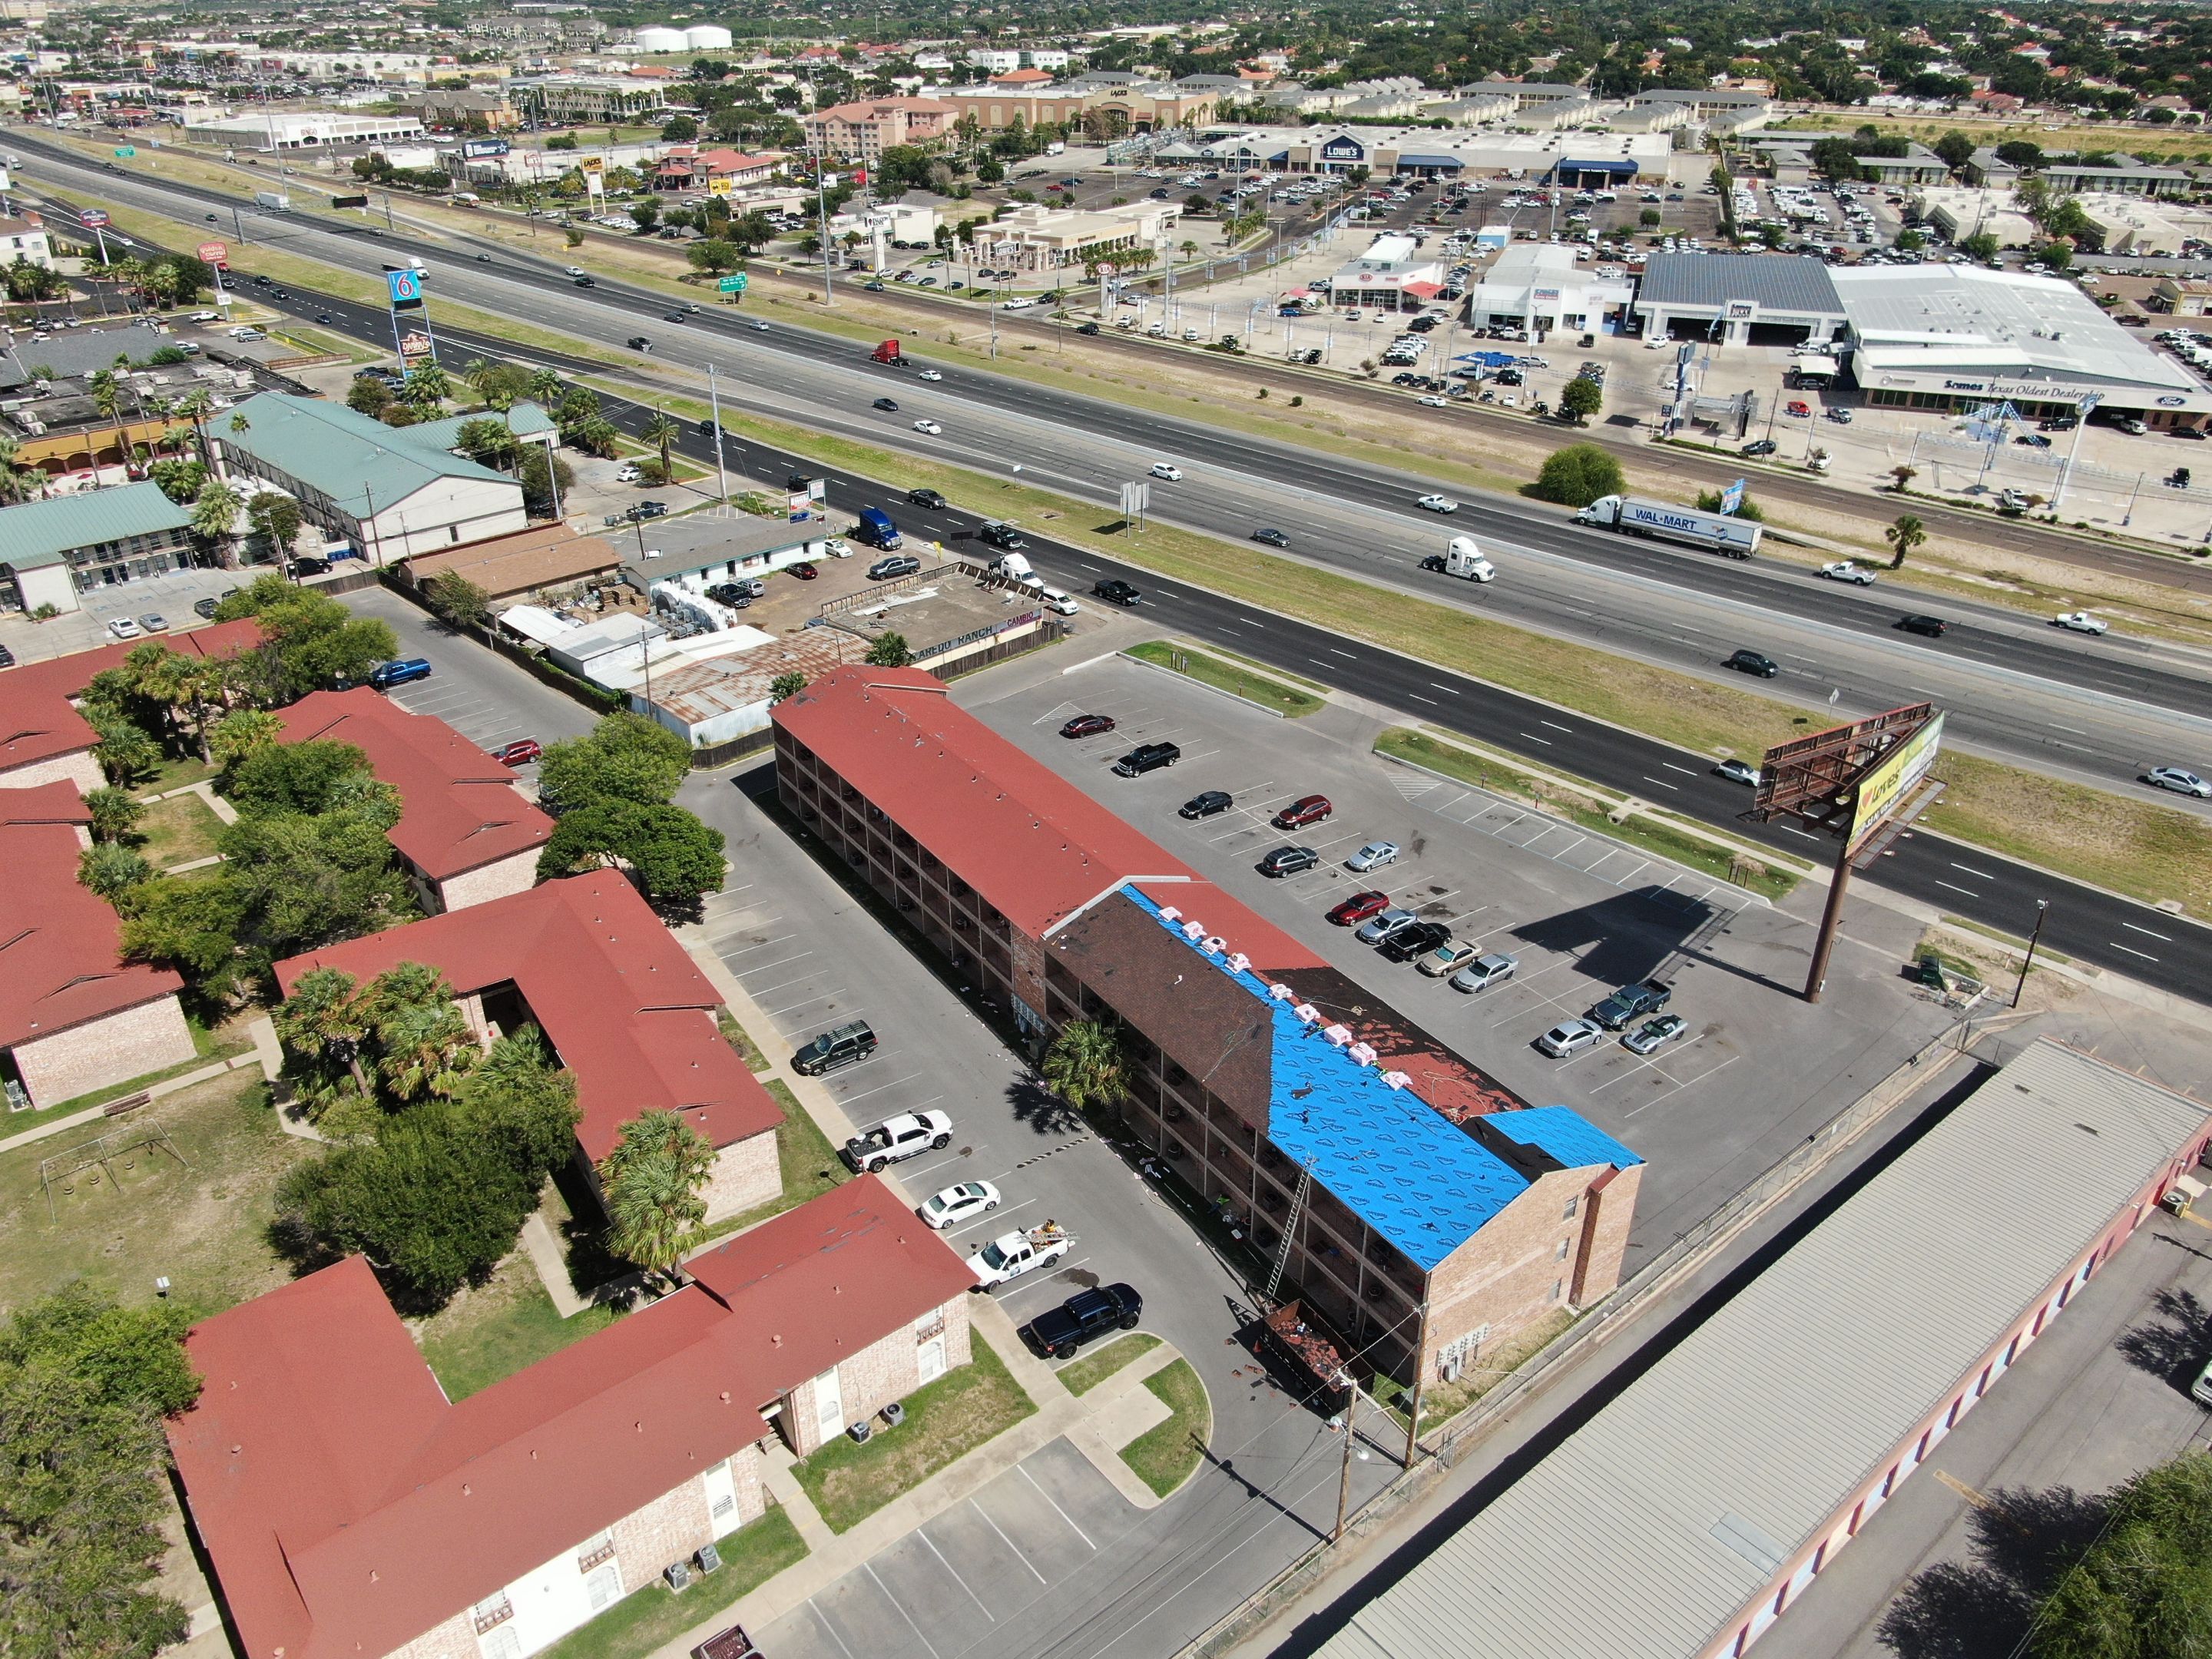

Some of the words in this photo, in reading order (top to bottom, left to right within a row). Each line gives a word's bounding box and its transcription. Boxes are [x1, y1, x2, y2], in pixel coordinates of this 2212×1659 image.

[1327, 146, 1357, 156] LOWE'S
[397, 273, 413, 297] 6
[1988, 383, 2014, 393] Texas
[2017, 386, 2049, 396] Oldest
[1007, 612, 1033, 627] CAMBIO
[958, 625, 992, 645] RANCH
